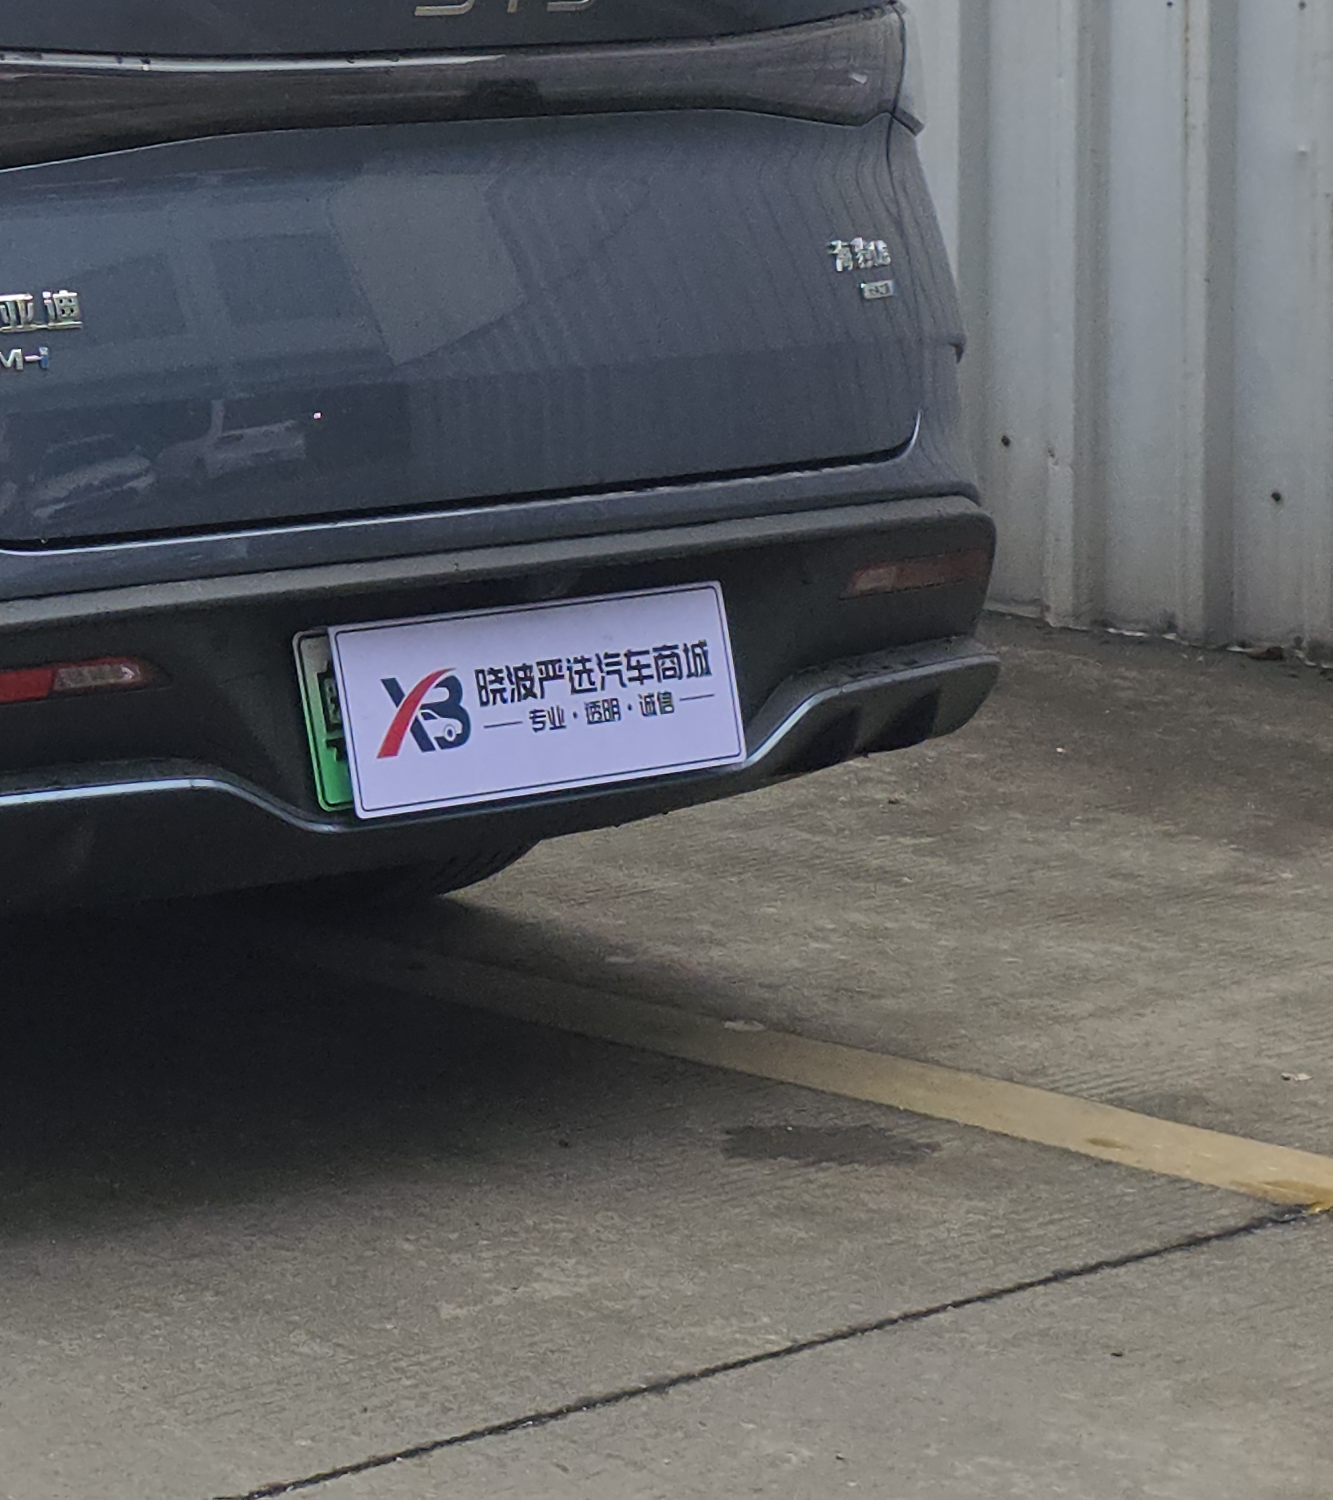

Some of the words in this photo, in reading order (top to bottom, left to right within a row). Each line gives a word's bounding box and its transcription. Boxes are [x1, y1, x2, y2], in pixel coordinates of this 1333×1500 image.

[475, 639, 712, 707] 晓波严选汽车商城
